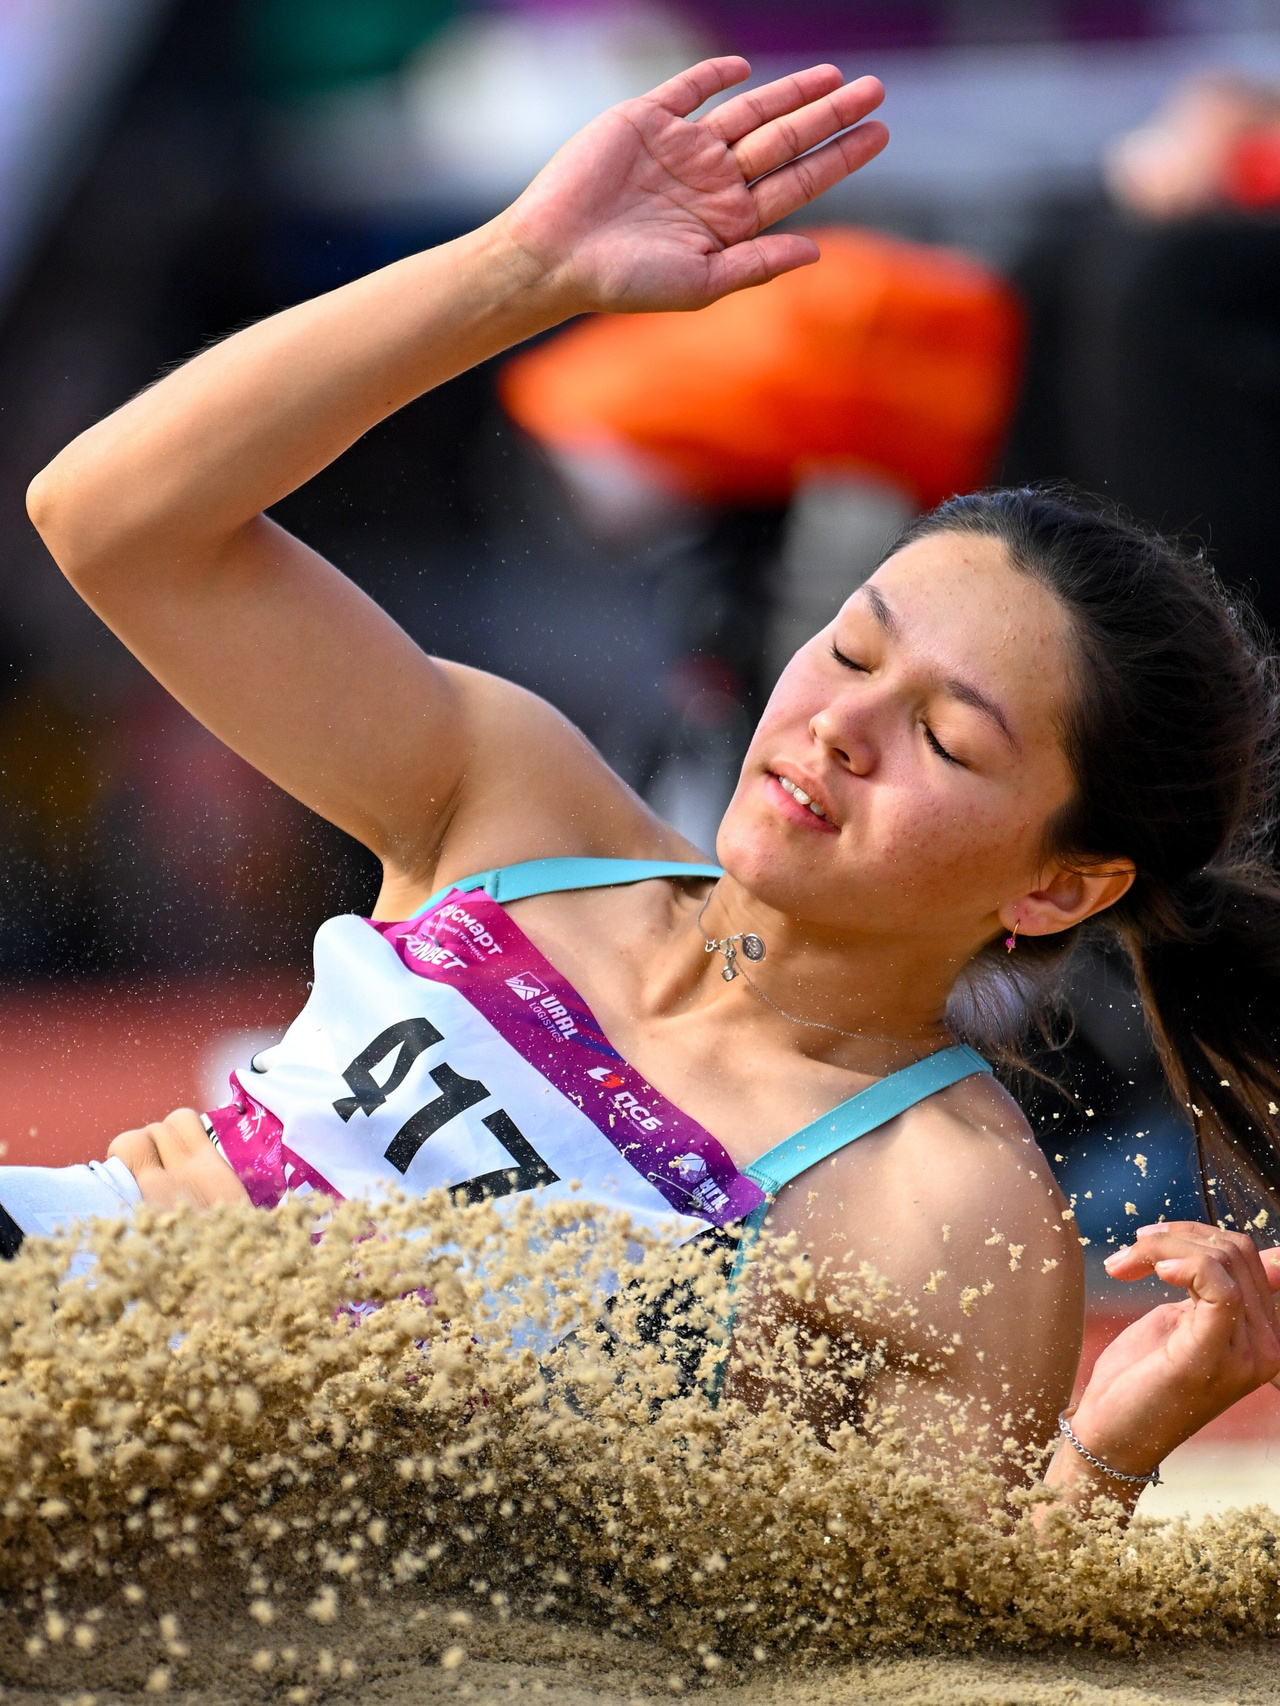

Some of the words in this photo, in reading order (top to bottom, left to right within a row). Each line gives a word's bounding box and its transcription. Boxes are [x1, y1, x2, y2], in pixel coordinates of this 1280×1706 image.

[529, 1002, 565, 1044] LOGISTICS
[540, 994, 579, 1041] URAL
[332, 1017, 562, 1208] 417
[614, 1091, 663, 1131] ПСБ
